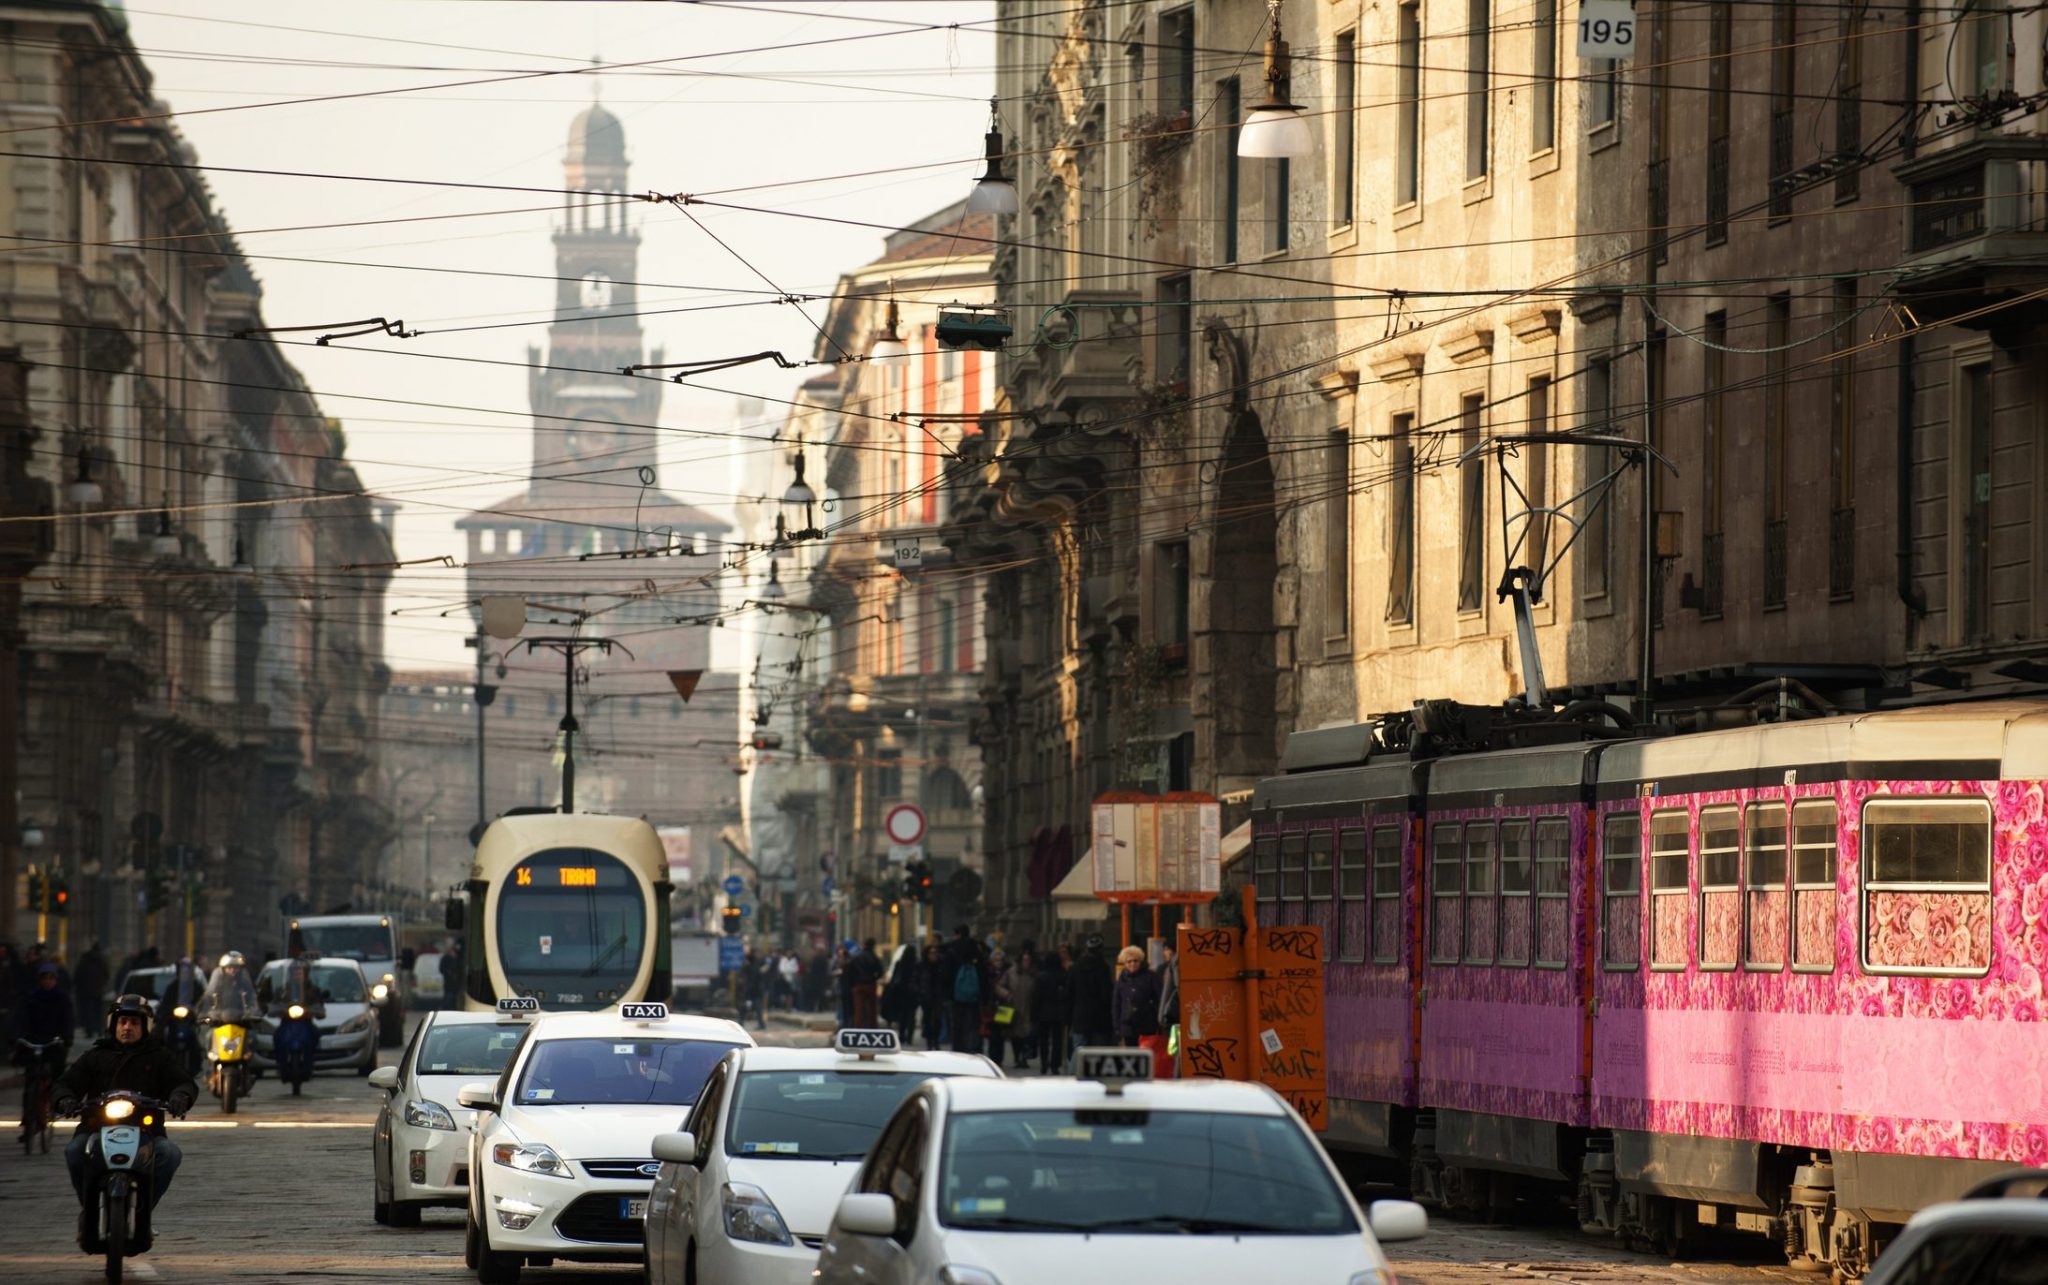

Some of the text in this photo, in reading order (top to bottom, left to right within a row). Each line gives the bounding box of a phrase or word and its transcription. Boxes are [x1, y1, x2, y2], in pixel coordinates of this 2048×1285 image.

[1580, 18, 1633, 45] 195
[896, 547, 920, 560] 192
[517, 867, 531, 886] 14
[502, 1000, 534, 1009] TAXI
[624, 1006, 663, 1017] TAXI
[844, 1033, 892, 1047] TAXI
[1086, 1056, 1147, 1076] TAXI
